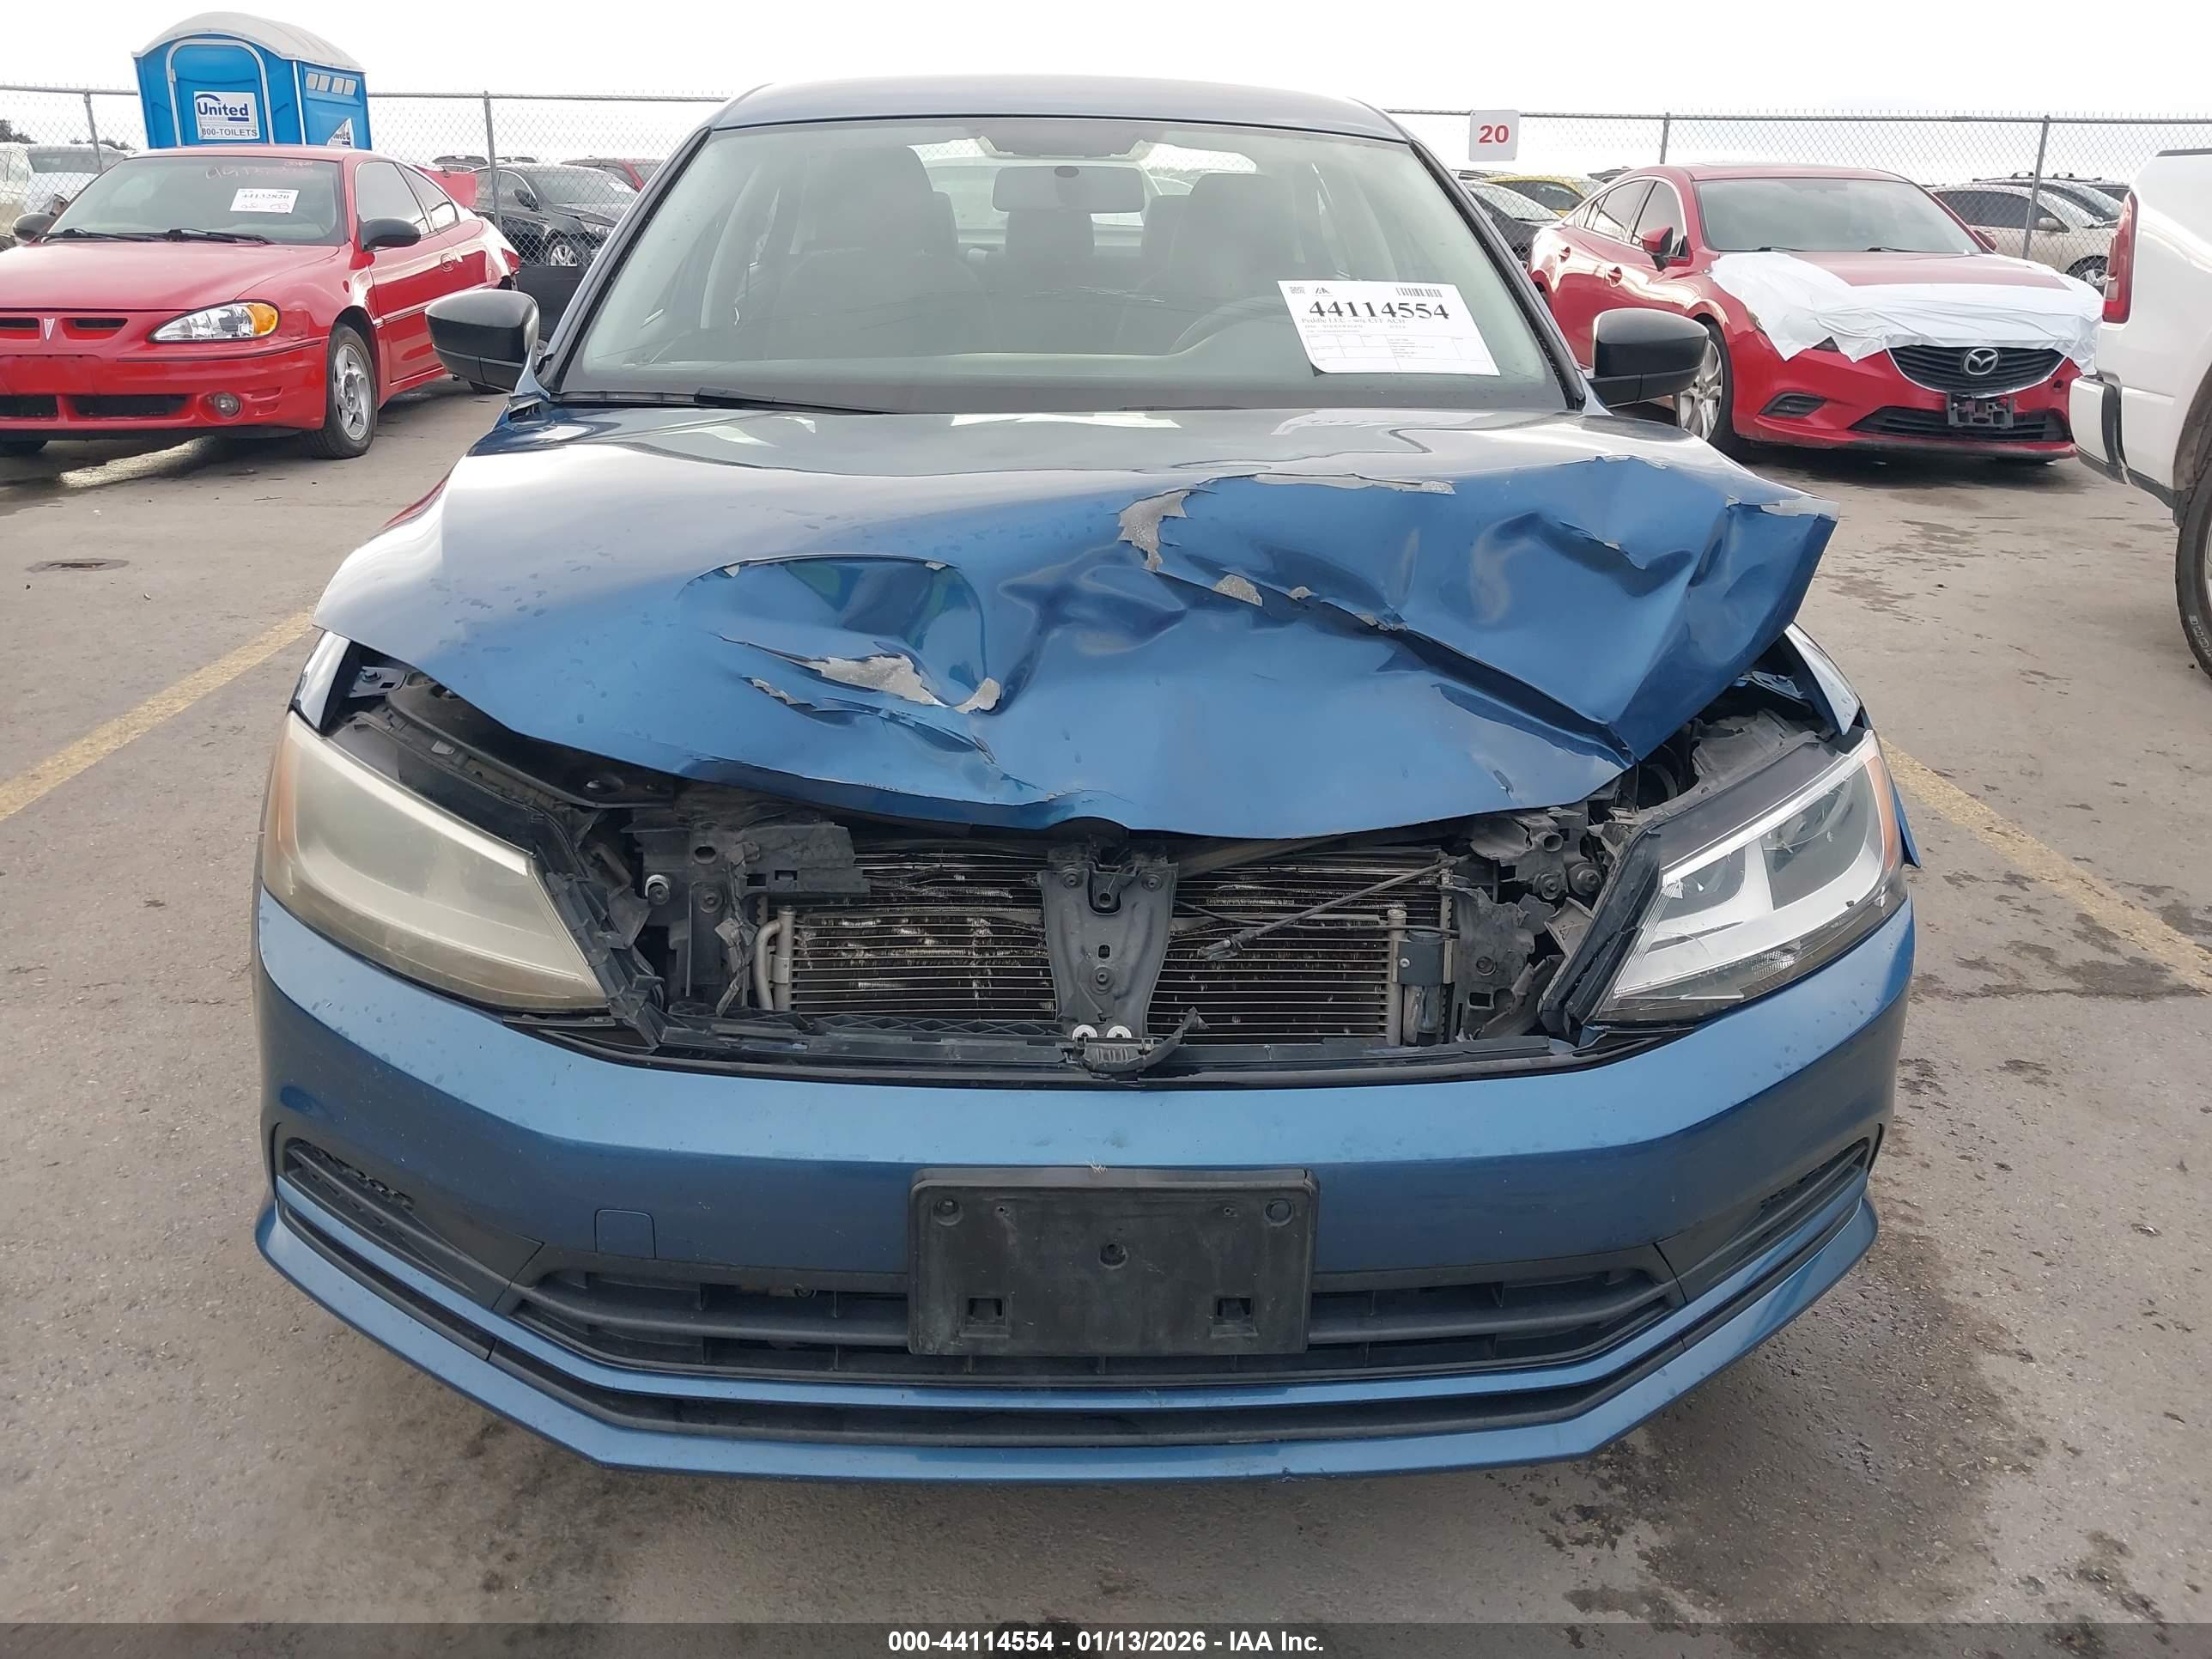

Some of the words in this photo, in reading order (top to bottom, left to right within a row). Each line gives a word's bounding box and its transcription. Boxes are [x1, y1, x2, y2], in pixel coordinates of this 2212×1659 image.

[198, 102, 249, 116] United
[1479, 125, 1510, 143] 20
[1310, 301, 1449, 319] 44114554
